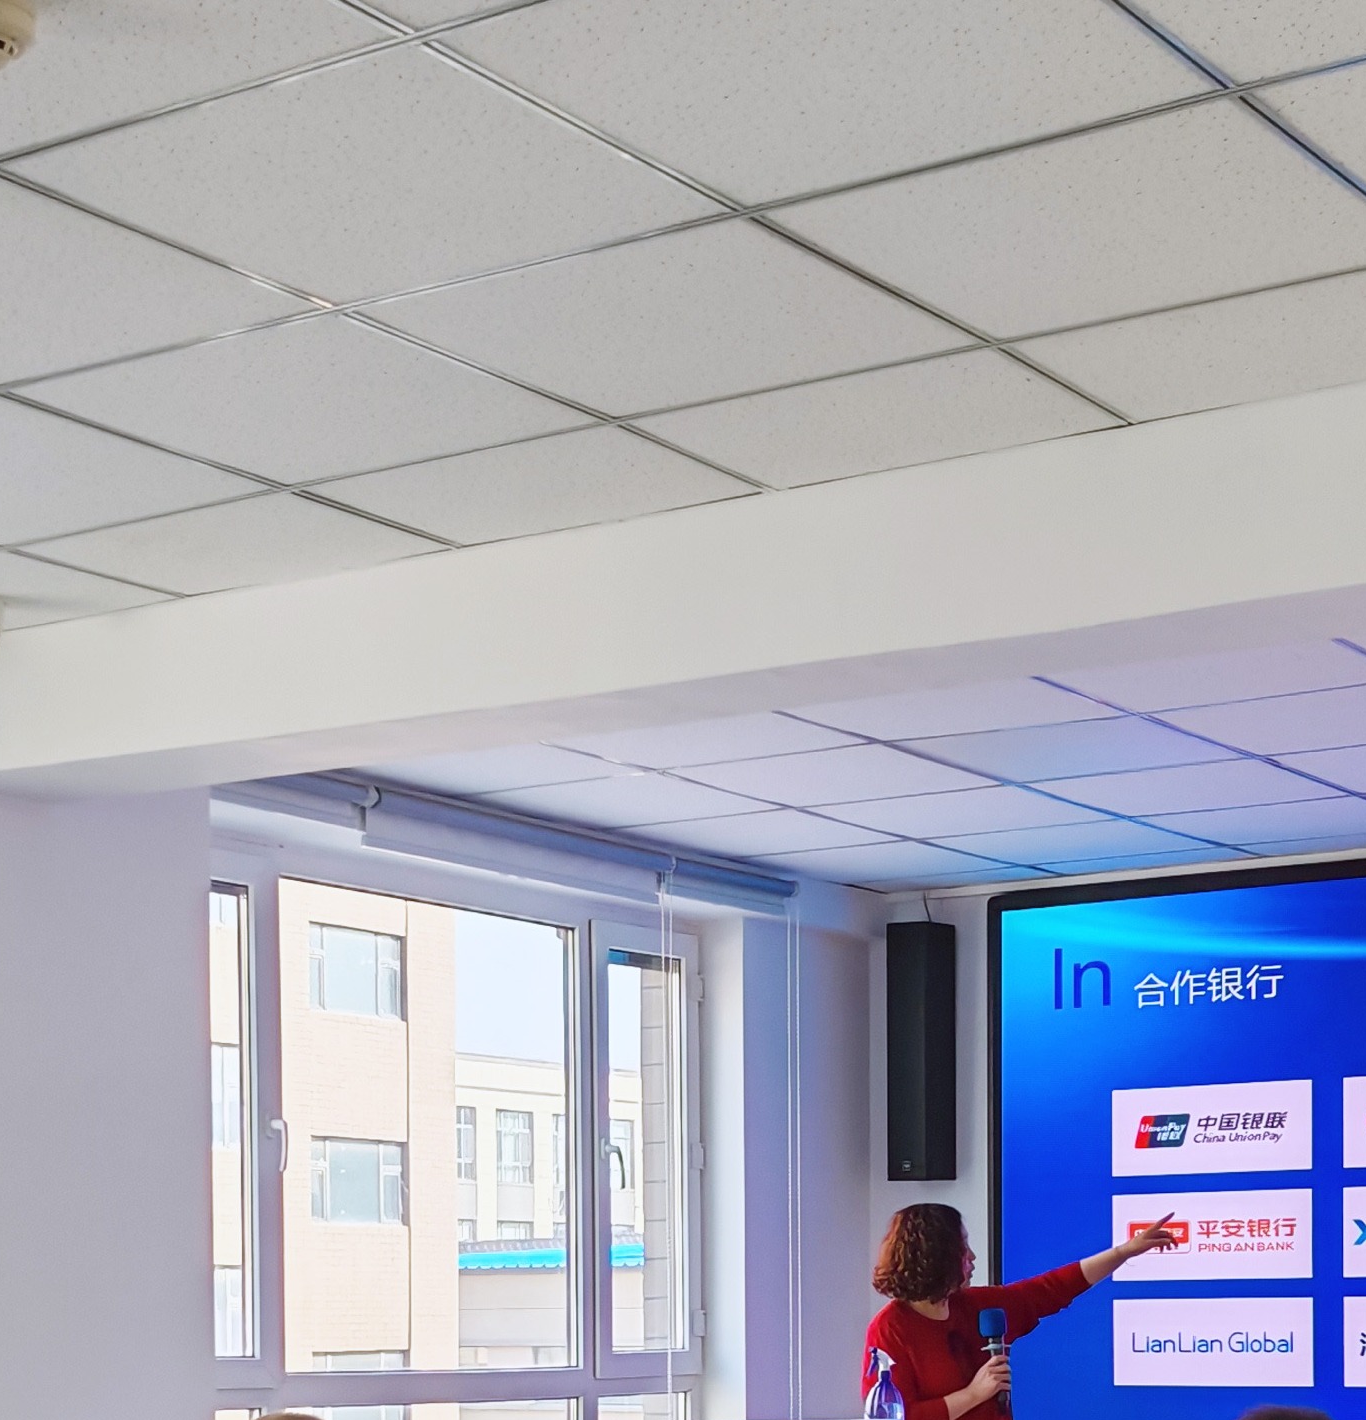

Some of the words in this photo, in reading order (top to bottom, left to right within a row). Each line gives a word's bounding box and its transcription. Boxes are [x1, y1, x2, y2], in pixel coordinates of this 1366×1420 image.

[1134, 964, 1284, 1009] 合作银行
[1196, 1111, 1288, 1131] 中国银联
[1193, 1133, 1226, 1144] China
[1197, 1217, 1296, 1238] 平安银行
[1257, 1241, 1295, 1251] BANK
[1132, 1331, 1223, 1353] LianLian
[1228, 1331, 1294, 1353] Global
